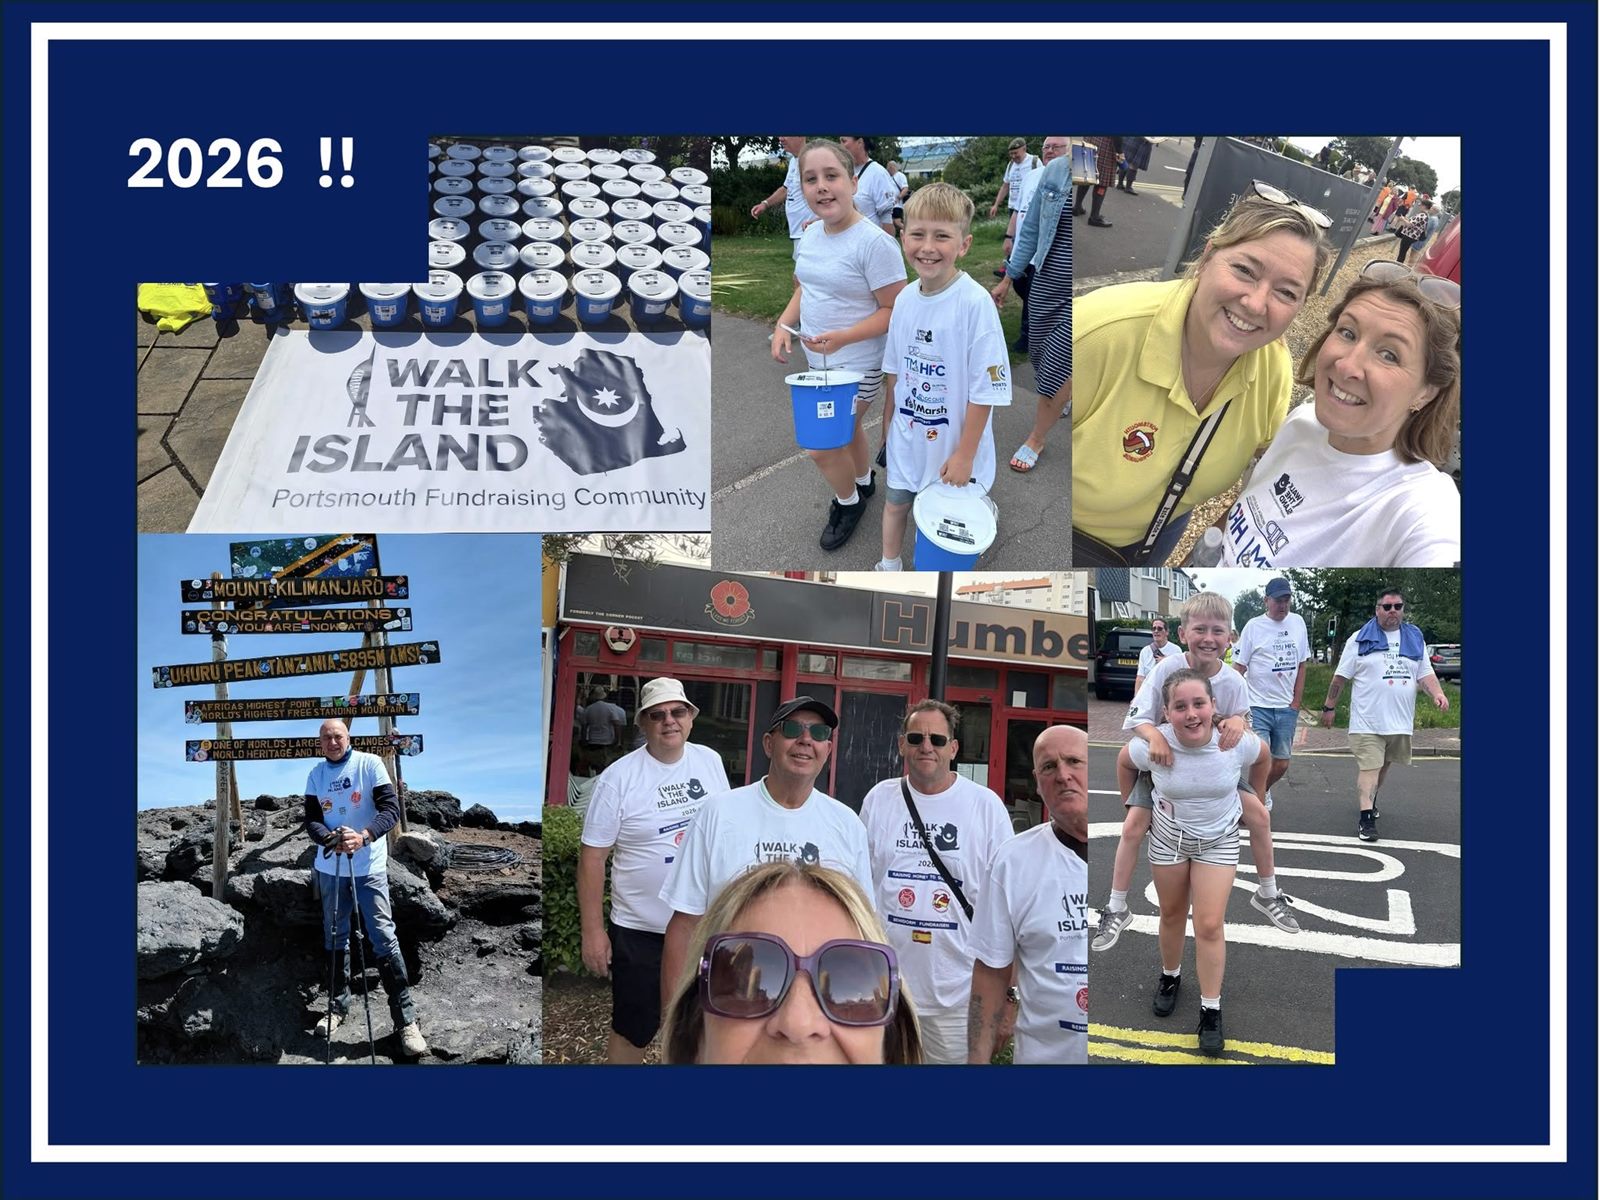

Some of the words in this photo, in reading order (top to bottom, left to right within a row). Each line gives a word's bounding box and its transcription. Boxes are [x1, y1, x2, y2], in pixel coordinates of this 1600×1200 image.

[386, 358, 543, 388] WALK
[919, 362, 946, 377] HFC
[396, 393, 509, 427] THE
[286, 433, 529, 474] ISLAND
[271, 487, 416, 509] Portsmouth
[425, 487, 566, 511] Fundraising
[574, 487, 706, 510] Community
[214, 581, 270, 597] MOUNT
[276, 579, 384, 597] KILIMANJARO
[197, 609, 393, 622] CONGRATULATIONS
[237, 622, 265, 632] YOU
[274, 622, 303, 632] ARE
[348, 621, 365, 631] AT
[169, 664, 221, 684] UHURU
[223, 660, 263, 680] PEAK
[340, 649, 386, 669] 5895M
[246, 701, 286, 710] HIGHEST
[290, 699, 317, 709] POINT
[243, 709, 284, 719] HIGHEST
[287, 707, 312, 718] FREE
[314, 706, 357, 716] STANDING
[361, 704, 405, 715] MOUNTAIN
[213, 741, 232, 750] ONE
[233, 740, 245, 749] OF
[288, 738, 320, 748] LARGE
[354, 737, 389, 747] CANOES
[213, 750, 245, 759] WORLD
[246, 748, 293, 759] HERITAGE
[294, 747, 313, 757] AND
[662, 782, 687, 793] WALK
[667, 790, 684, 799] THE
[657, 796, 689, 809] ISLAND
[681, 807, 697, 817] 2026
[908, 822, 938, 832] WLK
[761, 841, 798, 853] WALK
